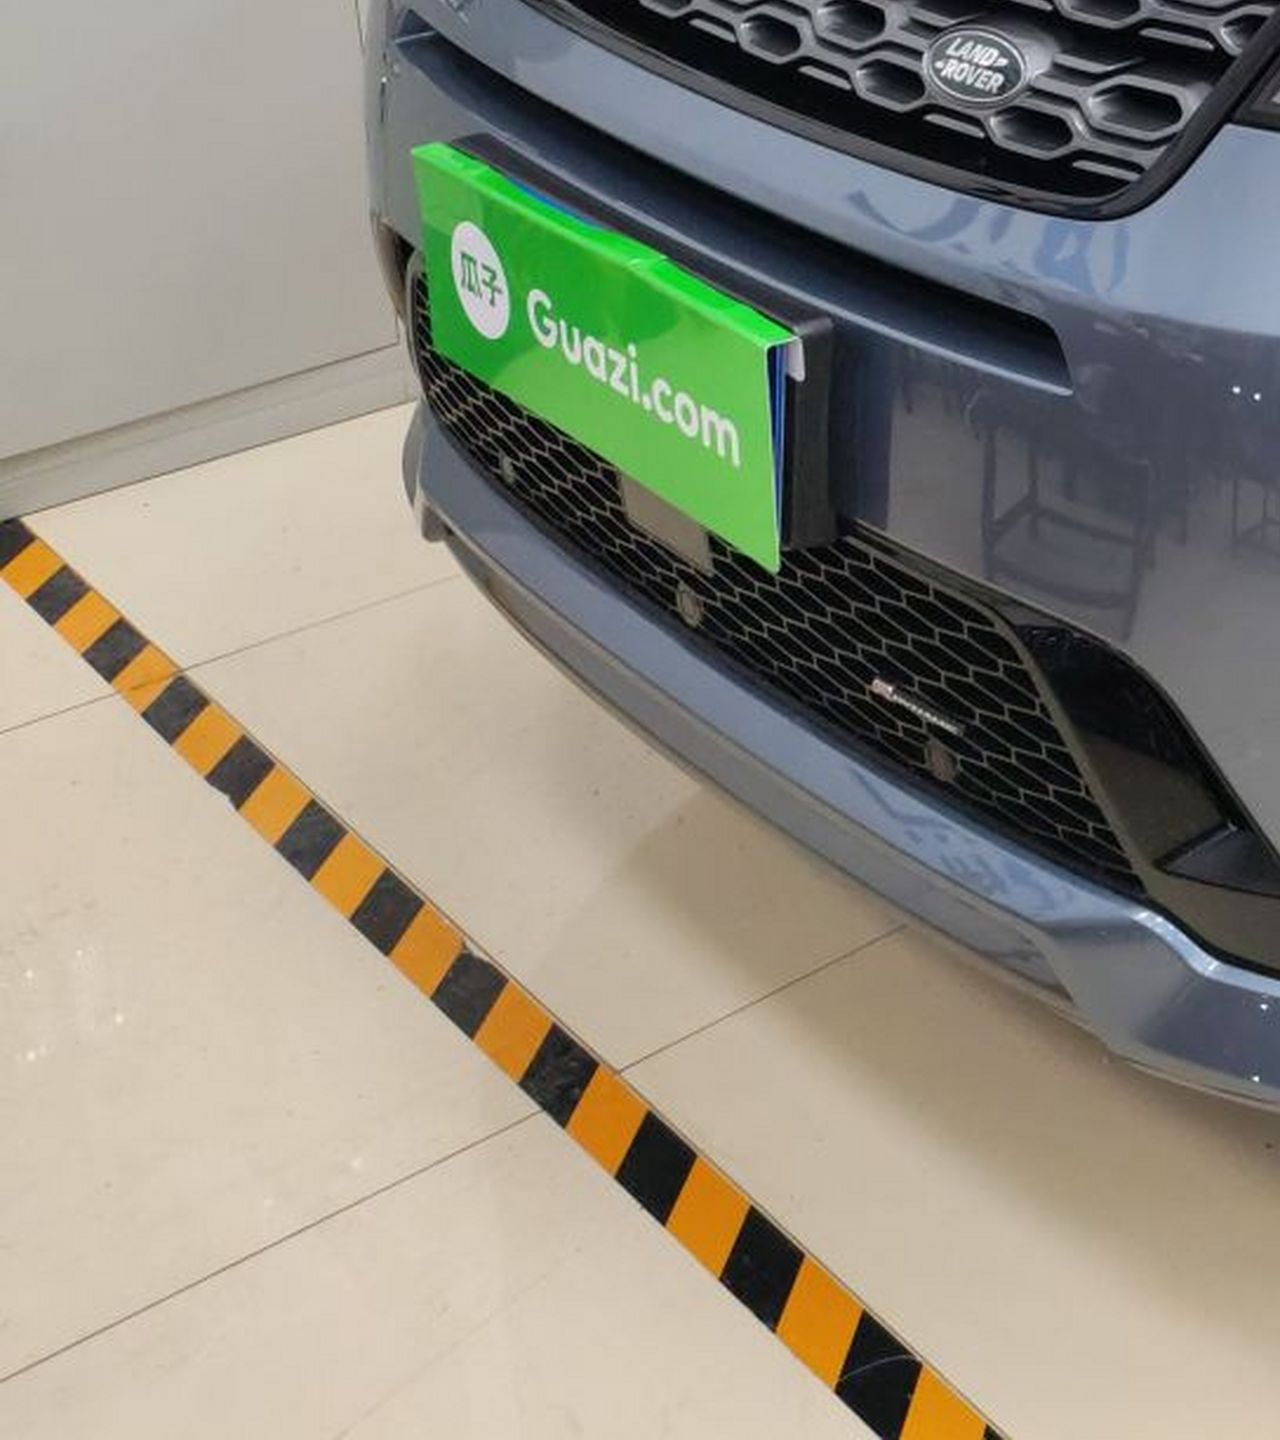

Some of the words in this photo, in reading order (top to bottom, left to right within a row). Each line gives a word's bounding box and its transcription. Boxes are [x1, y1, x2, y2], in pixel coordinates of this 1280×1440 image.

[946, 37, 1000, 67] LAND
[940, 60, 1005, 93] ROVER
[460, 251, 502, 307] 瓜子
[527, 288, 741, 467] Guazi.com
